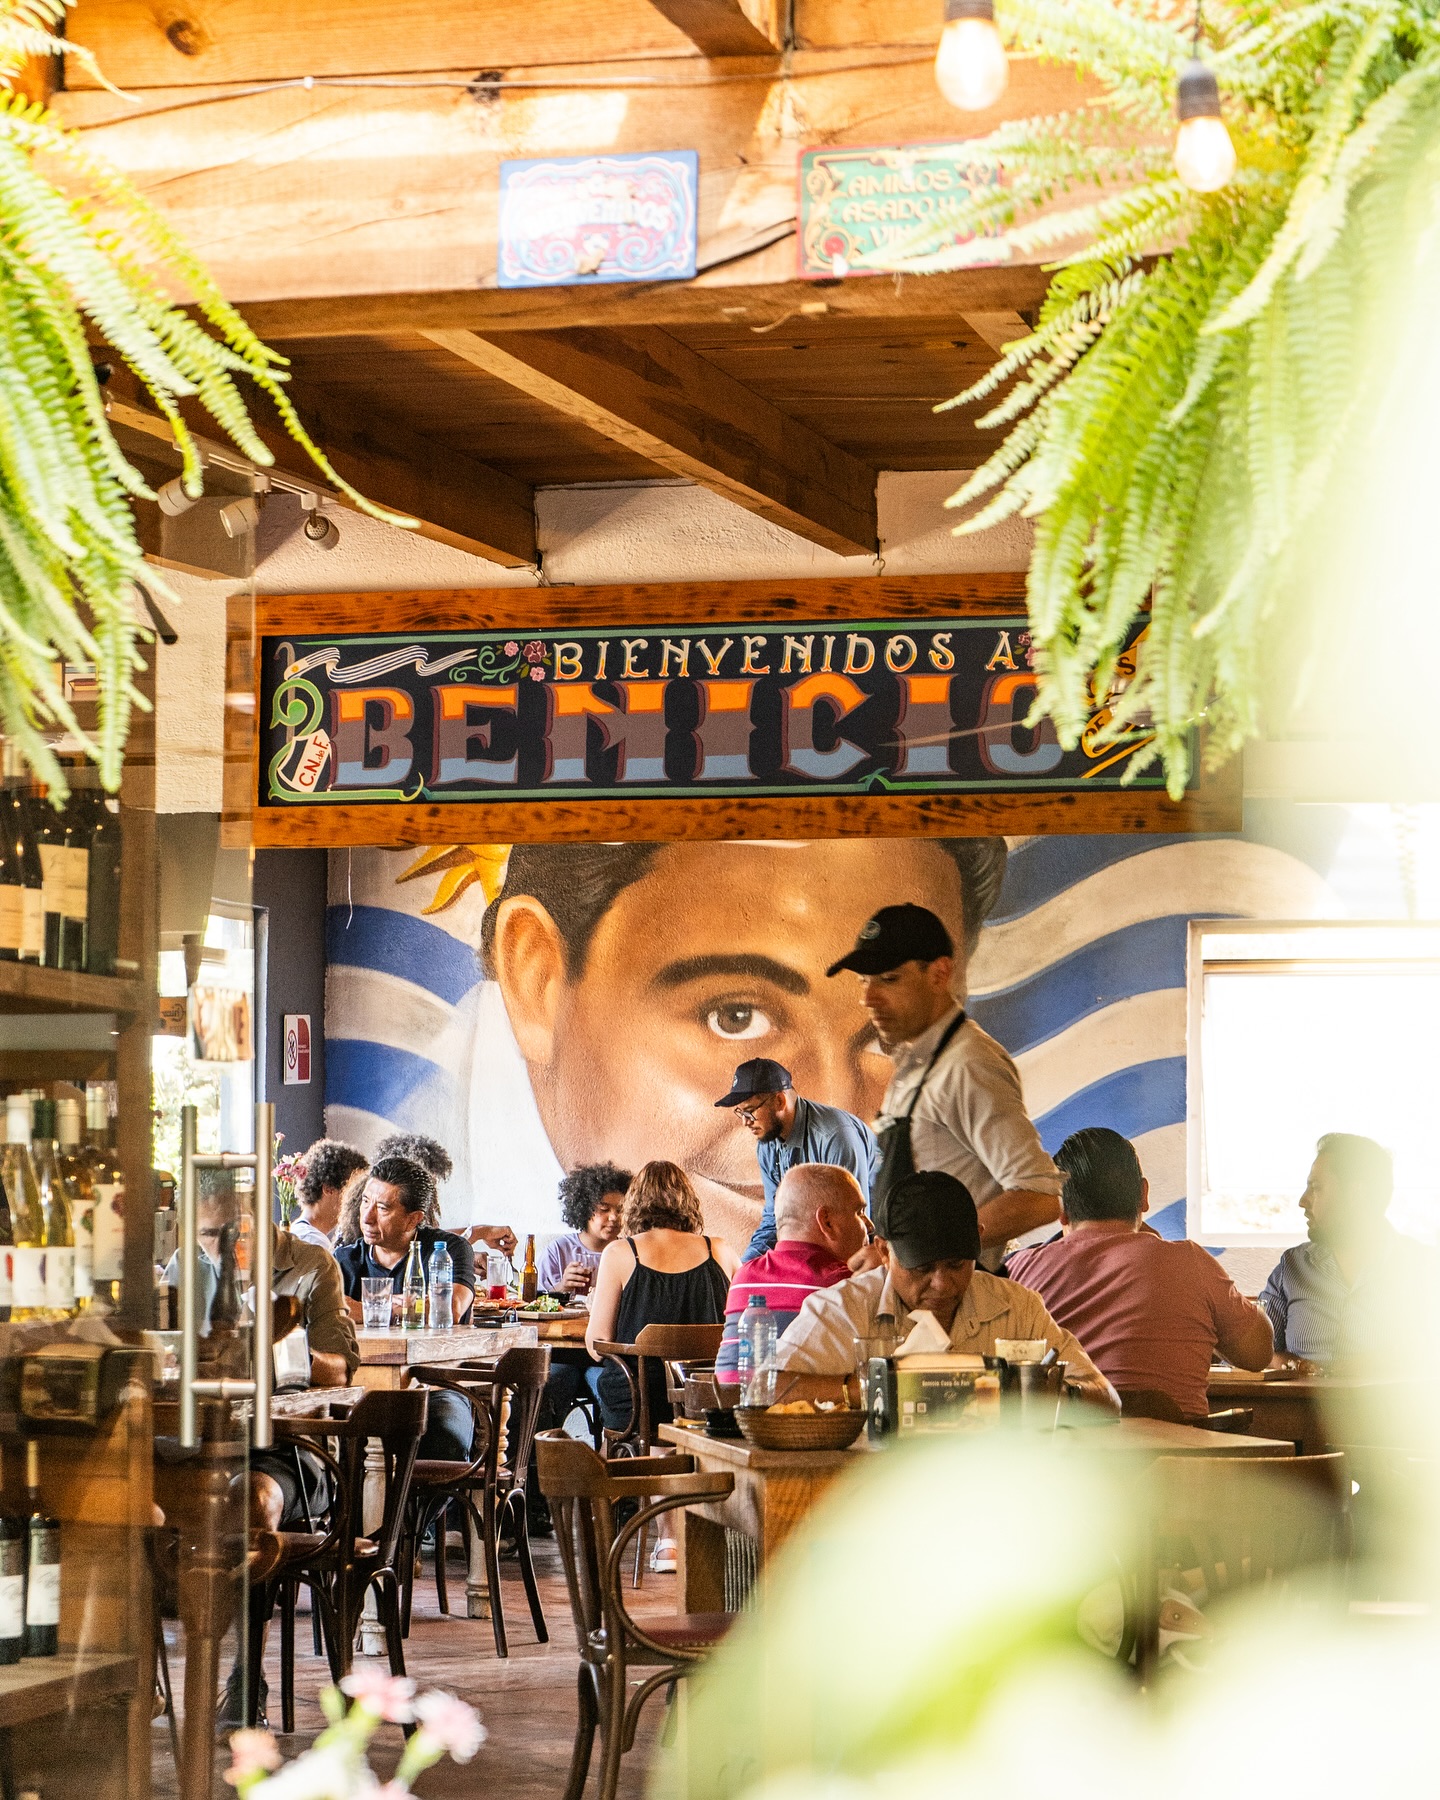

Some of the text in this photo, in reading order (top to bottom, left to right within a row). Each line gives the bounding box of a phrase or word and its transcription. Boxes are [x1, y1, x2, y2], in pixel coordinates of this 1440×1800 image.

[841, 196, 934, 224] ASADO
[553, 630, 1020, 680] BIENVENIDOS A
[330, 671, 1064, 786] BENICIO
